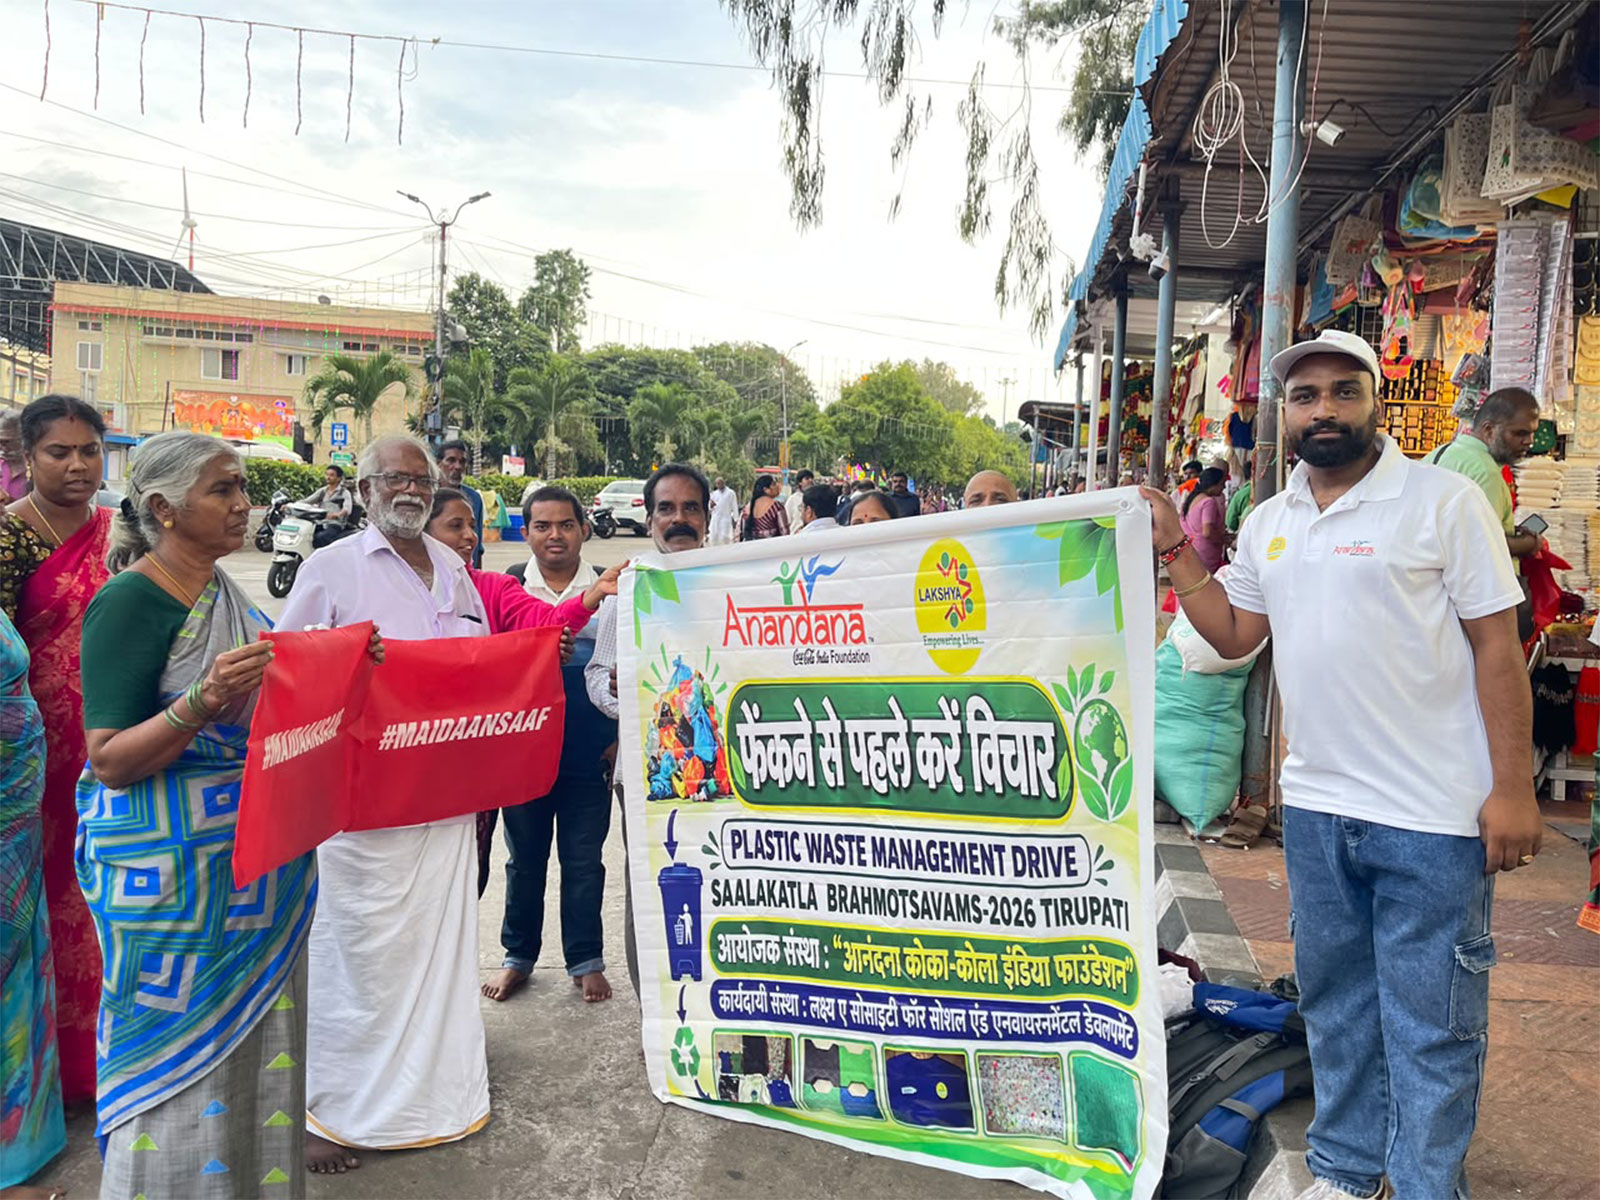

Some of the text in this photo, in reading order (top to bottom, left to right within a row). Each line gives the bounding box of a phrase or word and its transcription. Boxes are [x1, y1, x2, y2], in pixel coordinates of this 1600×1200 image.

[723, 580, 867, 647] Anandana
[918, 586, 962, 602] LAKSHYA
[830, 649, 870, 663] Foundation
[923, 634, 961, 648] Empowering
[378, 706, 551, 750] #MAIDAANSAAF
[736, 695, 1057, 799] फेंकने से पहले करें विचार
[731, 829, 1079, 879] PLASTIC WASTE MANAGEMENT DRIVE
[711, 878, 1130, 932] SAALAKATLA BRAHMOTSAVAMS-2026 TIRUPATI
[717, 924, 780, 963] आयोजक
[903, 937, 999, 984] कोका-कोला
[1001, 944, 1051, 990] इंडिया
[718, 982, 768, 1015] कार्यदायी
[809, 995, 835, 1023] लक्ष्य
[838, 998, 848, 1027] ए
[850, 992, 899, 1031] सोसाइटी
[901, 997, 926, 1029] फॉर
[928, 999, 966, 1032] सोशल
[969, 1002, 989, 1038] एंड
[991, 1004, 1081, 1038] एनवायरनमेंटल
[1083, 1003, 1134, 1050] डेवलपमेंट
